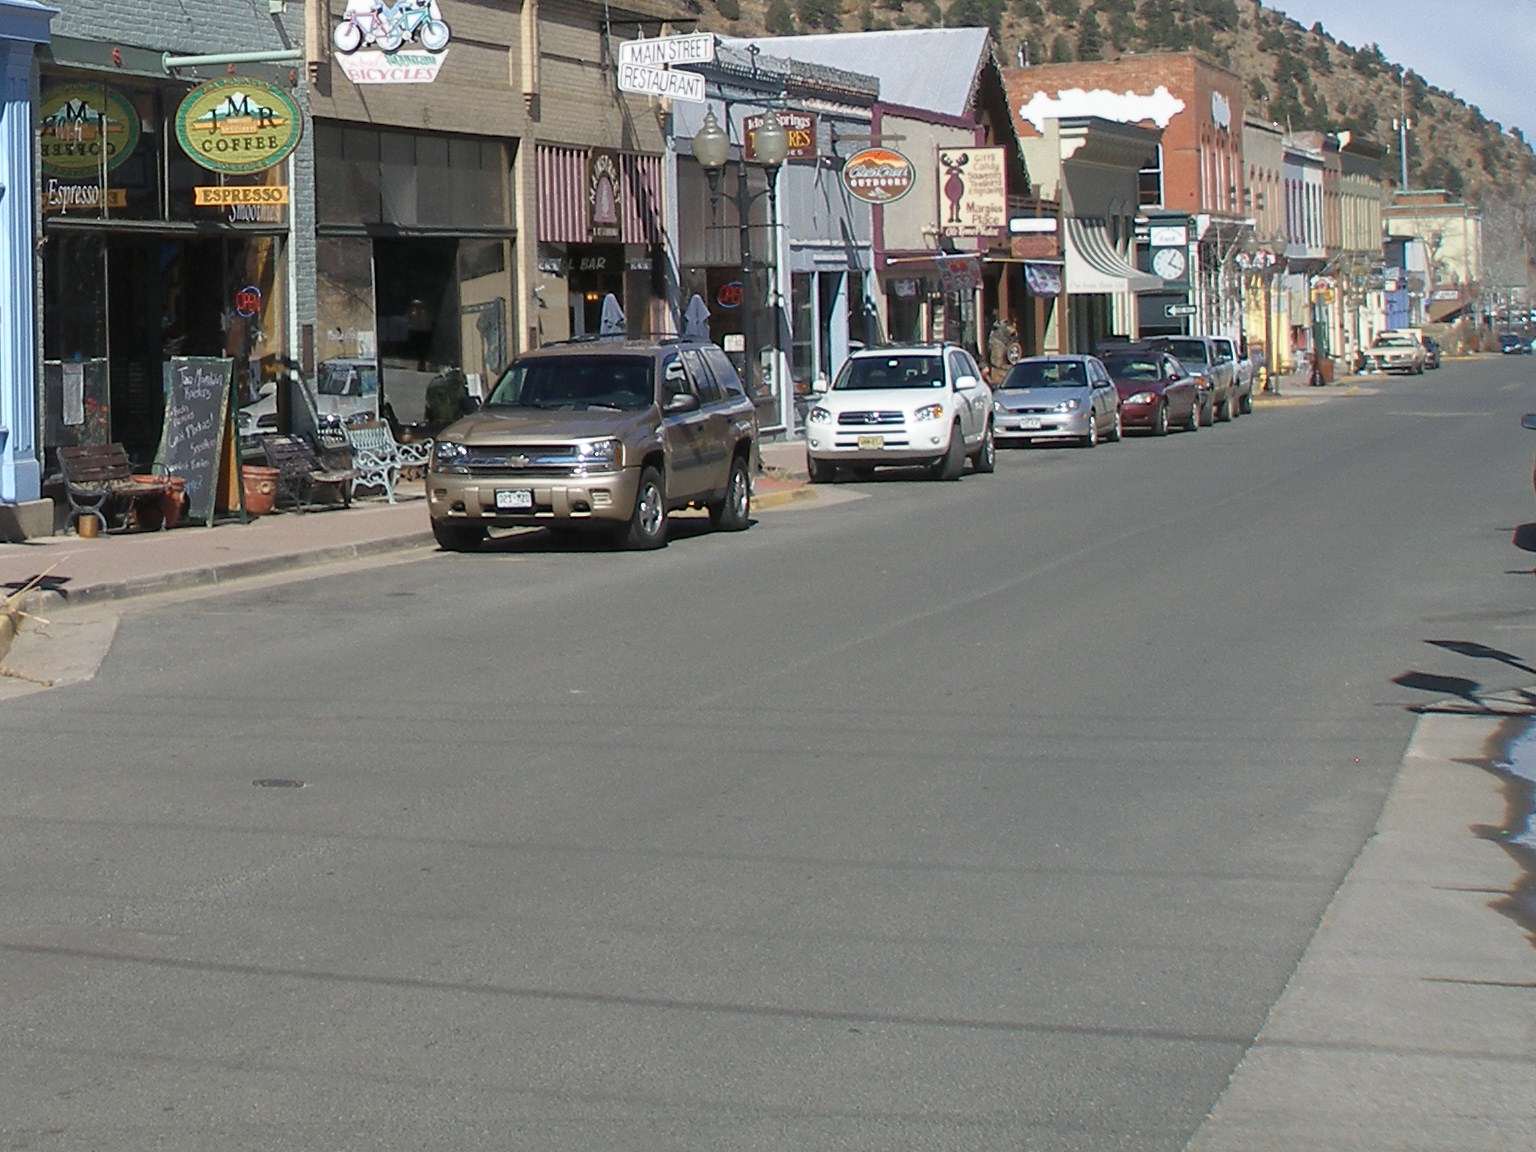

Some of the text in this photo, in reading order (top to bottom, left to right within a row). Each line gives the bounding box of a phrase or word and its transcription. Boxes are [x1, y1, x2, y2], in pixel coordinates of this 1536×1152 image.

[630, 38, 709, 63] MAIN STREET
[347, 68, 435, 81] BICYCLES
[624, 66, 701, 97] RESTAURANT
[201, 135, 279, 153] COFFEE
[850, 177, 908, 187] OUTDOORS
[47, 178, 100, 214] Espresso
[202, 188, 283, 203] ESPRESSO
[580, 256, 606, 270] BAR
